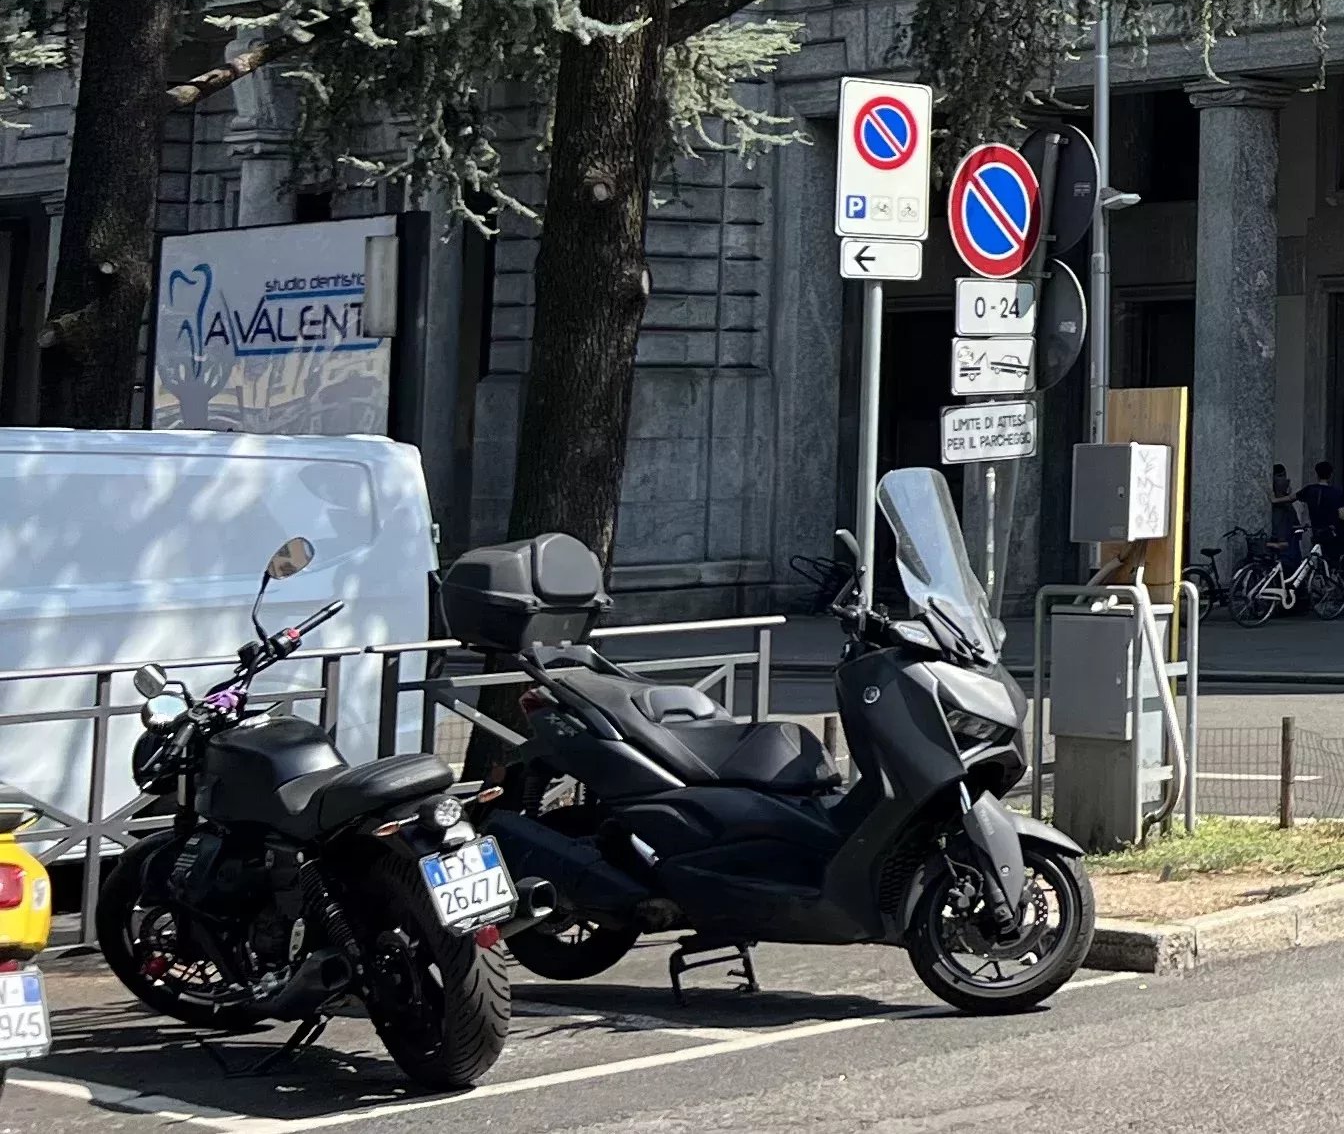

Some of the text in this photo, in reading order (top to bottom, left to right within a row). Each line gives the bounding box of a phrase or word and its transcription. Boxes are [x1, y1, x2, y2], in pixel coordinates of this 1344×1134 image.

[265, 272, 366, 293] studio dentistic
[1000, 296, 1020, 319] 24
[952, 413, 1027, 433] LIMITE DI ATTESA
[947, 431, 1032, 451] PER IL PARCHEGGIO
[442, 851, 473, 880] FX
[440, 873, 508, 915] 26474
